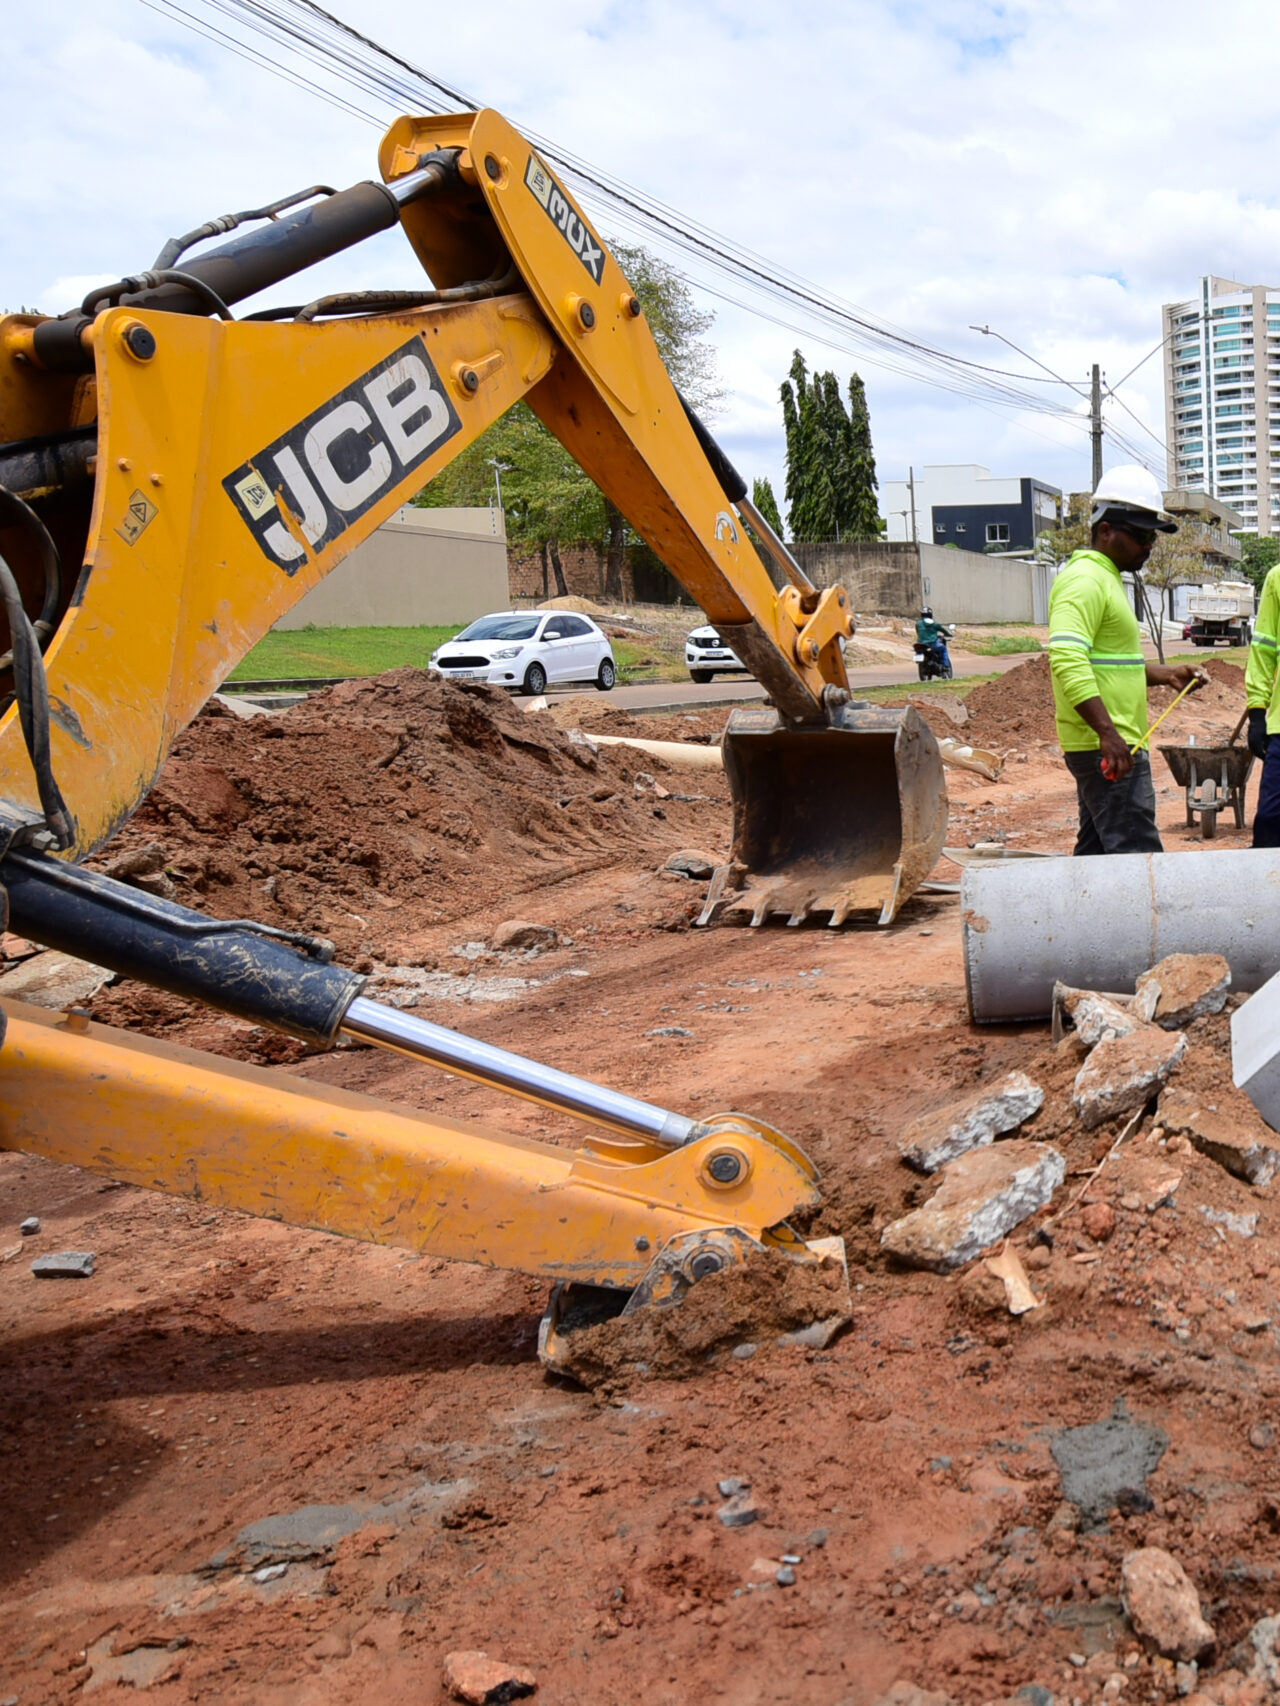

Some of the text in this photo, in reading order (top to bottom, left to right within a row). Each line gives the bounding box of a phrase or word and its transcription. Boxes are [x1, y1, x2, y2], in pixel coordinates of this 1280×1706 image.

[534, 171, 545, 192] JCB
[549, 189, 602, 280] 3CX
[263, 354, 450, 561] JCB
[246, 485, 266, 505] JCB
